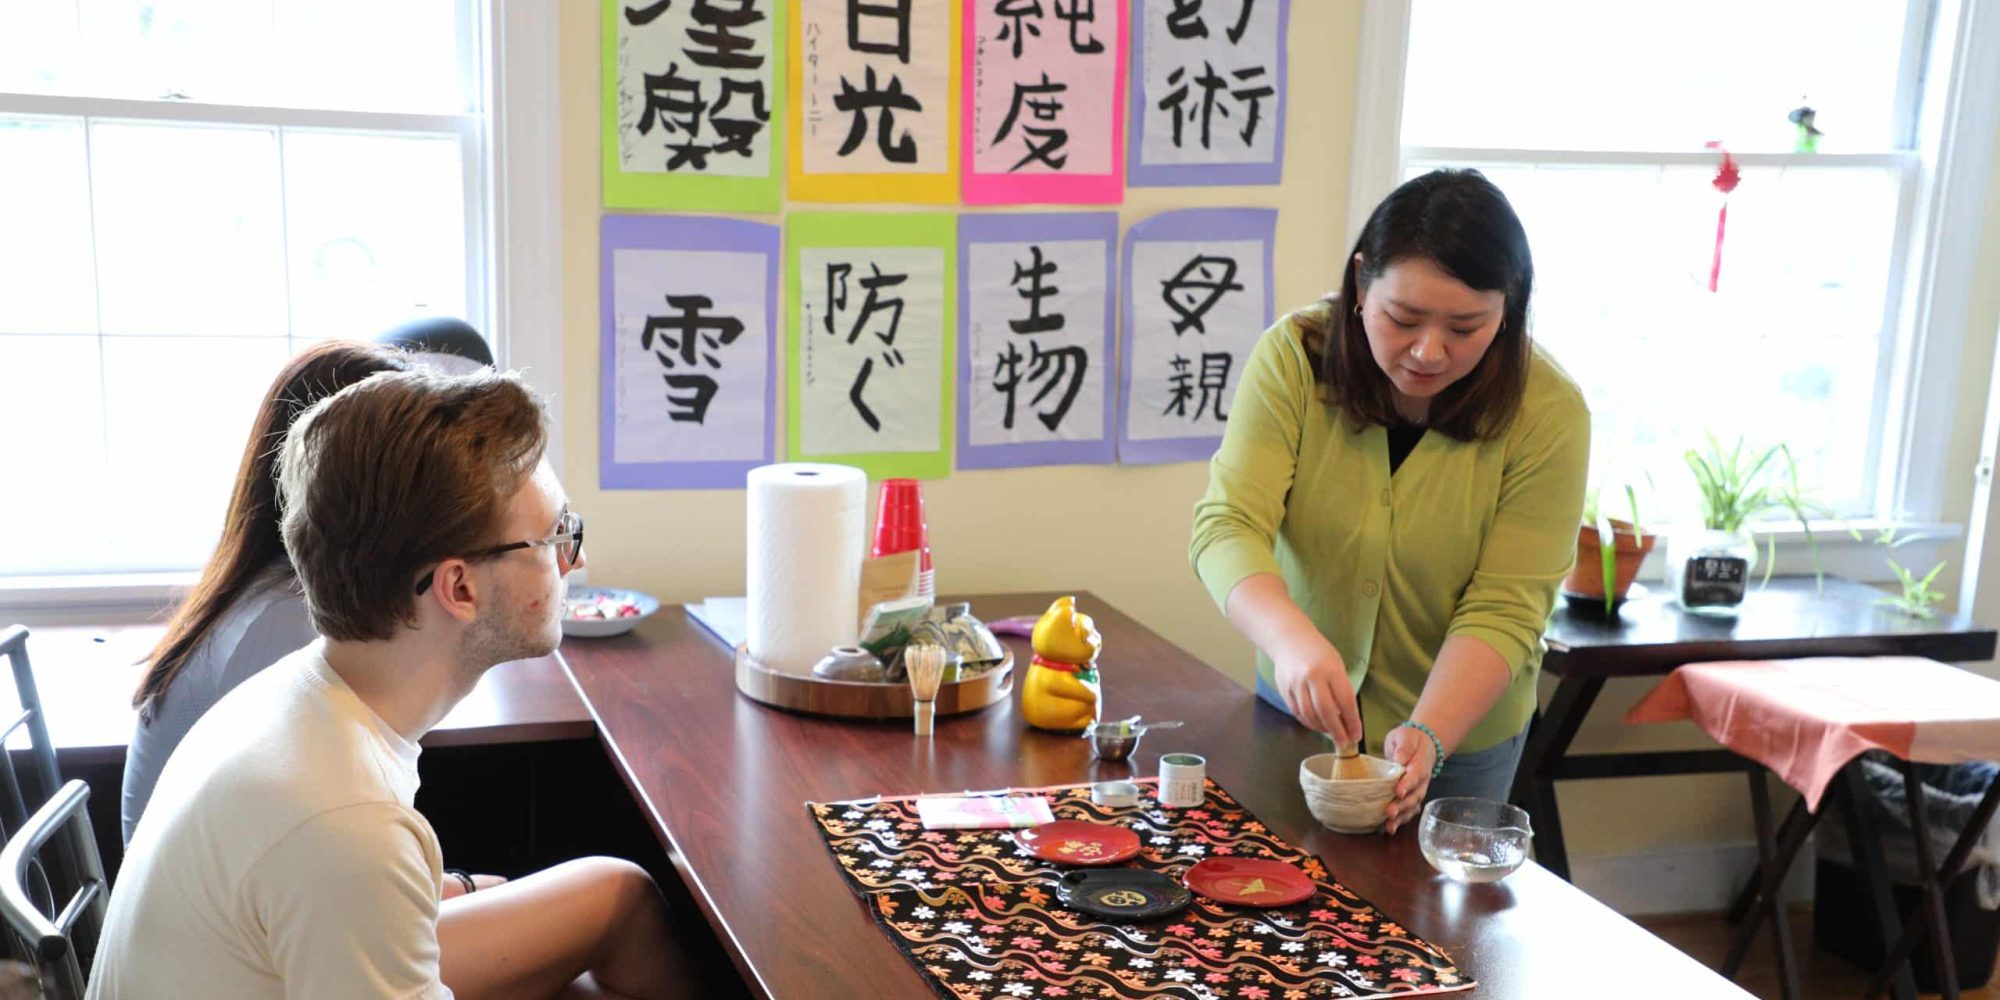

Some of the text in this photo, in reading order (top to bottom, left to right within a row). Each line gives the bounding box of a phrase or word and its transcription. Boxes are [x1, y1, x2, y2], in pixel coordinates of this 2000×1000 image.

[641, 294, 745, 425] 雪
[823, 261, 908, 432] 防ぐ
[992, 245, 1088, 431] 生物
[1160, 253, 1245, 424] 母親
